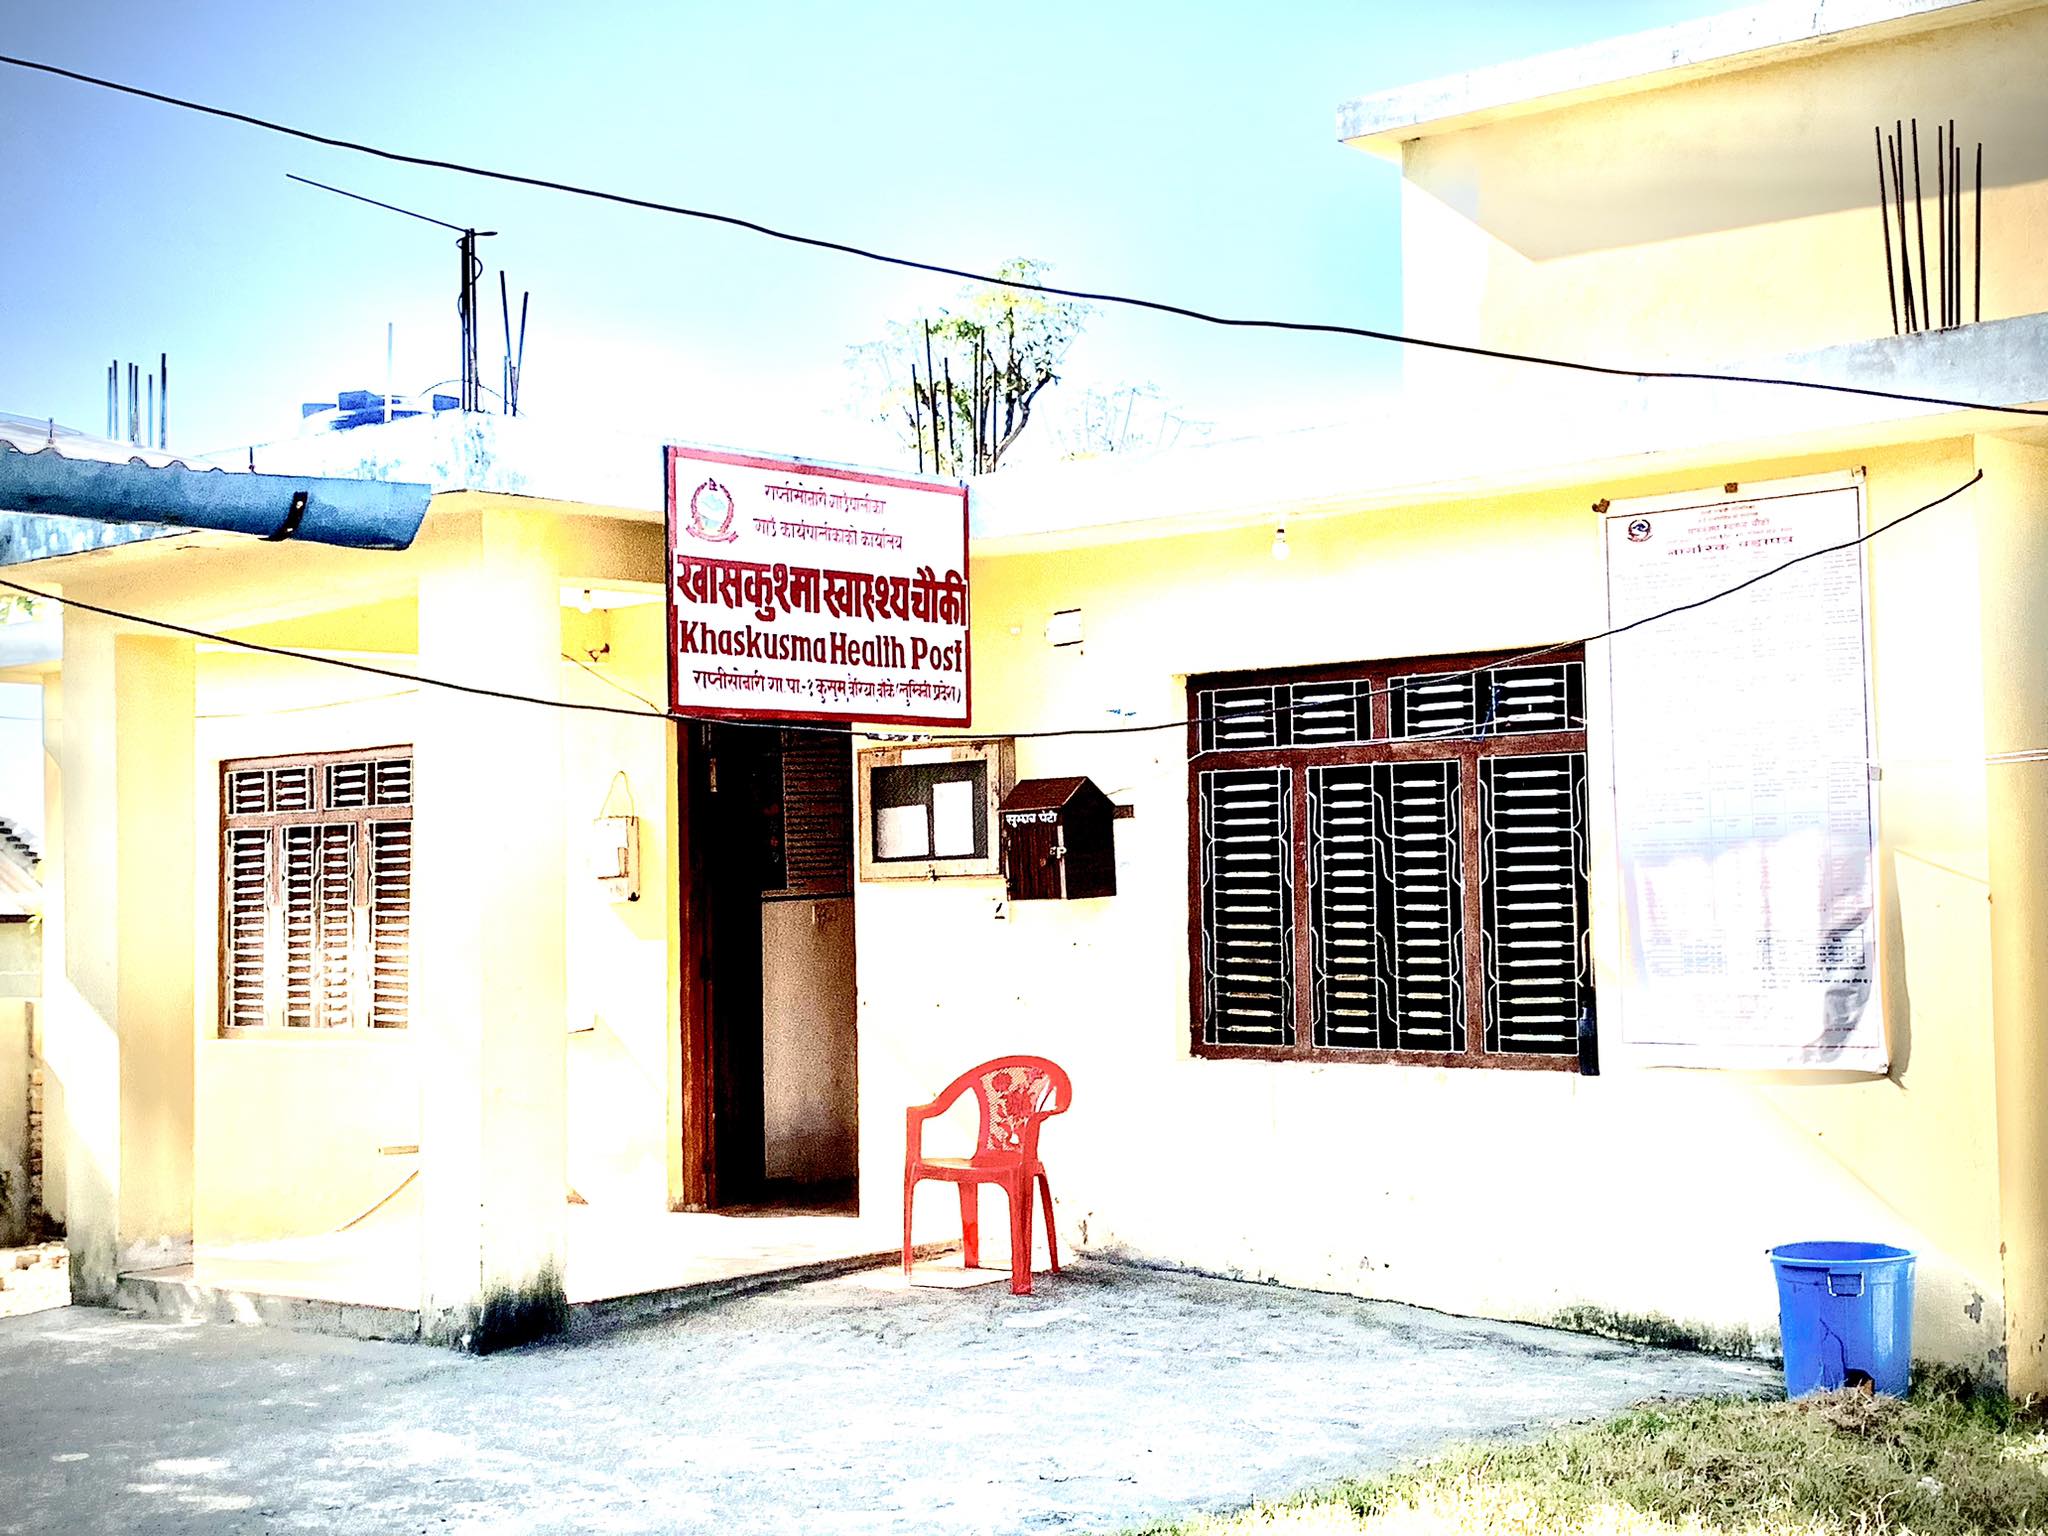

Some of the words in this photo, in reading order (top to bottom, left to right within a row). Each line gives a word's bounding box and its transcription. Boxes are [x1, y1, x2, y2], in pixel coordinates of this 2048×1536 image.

[910, 565, 967, 626] चौकी
[679, 619, 827, 665] Khaskusma
[829, 631, 907, 669] Health
[910, 636, 963, 673] Post
[1037, 809, 1058, 824] पेटी
